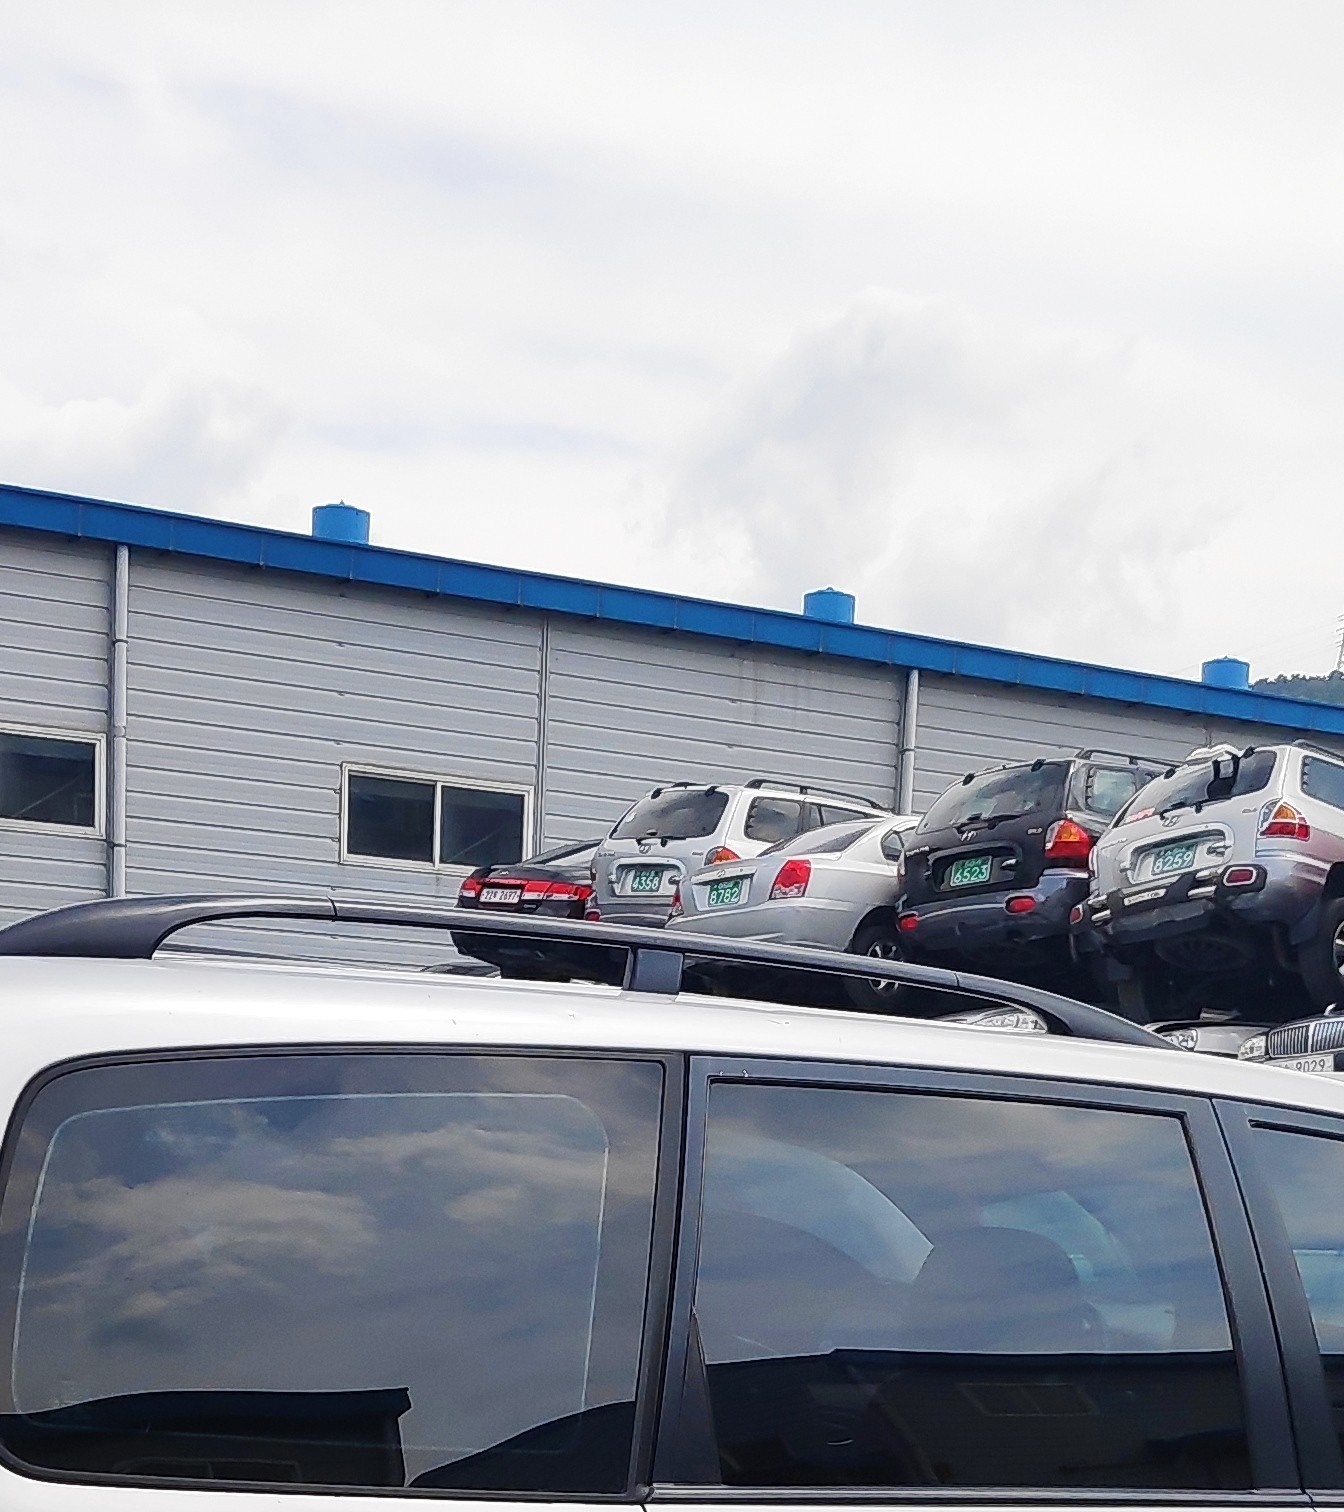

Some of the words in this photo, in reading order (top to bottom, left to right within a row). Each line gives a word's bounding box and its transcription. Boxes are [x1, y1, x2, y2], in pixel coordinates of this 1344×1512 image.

[1155, 851, 1193, 873] 8259
[632, 876, 659, 890] 4358
[953, 864, 988, 884] 6523
[709, 888, 740, 905] 8782
